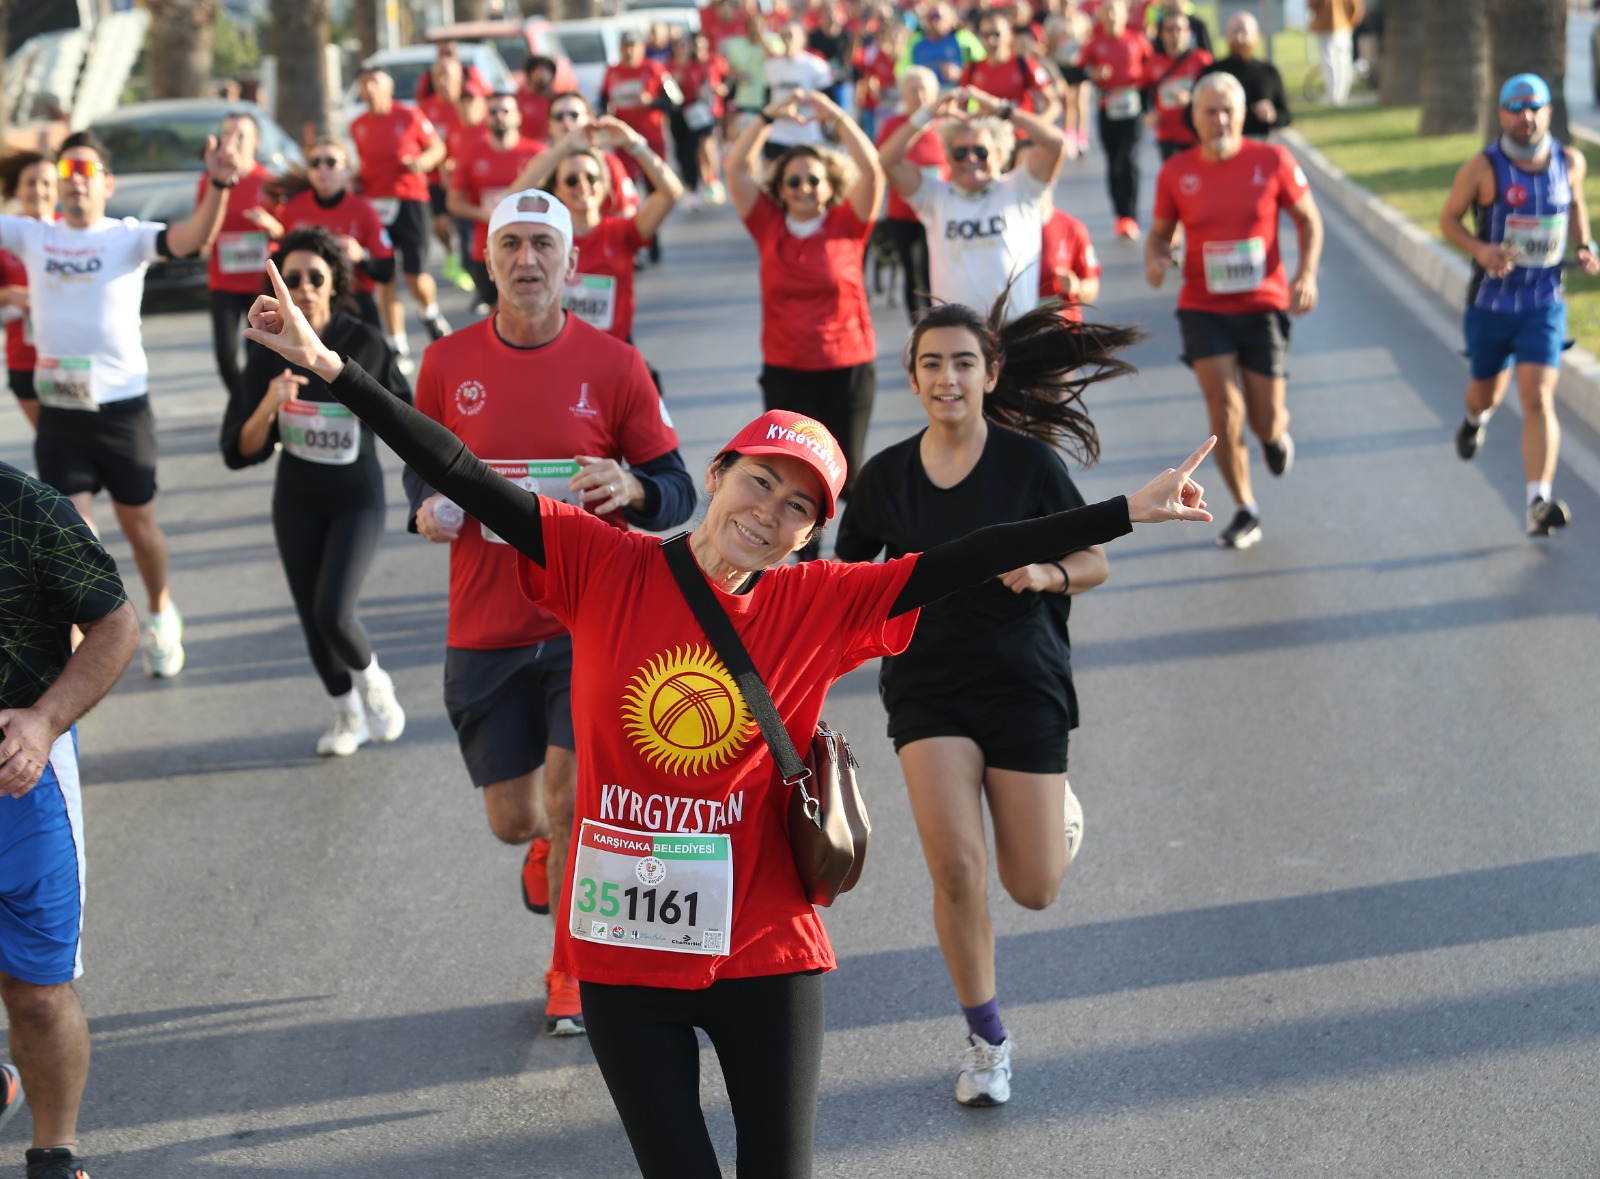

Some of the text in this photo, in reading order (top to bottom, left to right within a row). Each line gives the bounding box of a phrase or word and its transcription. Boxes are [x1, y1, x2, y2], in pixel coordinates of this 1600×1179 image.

[528, 465, 572, 474] BELEDİYESİ
[766, 424, 842, 483] KYRGYZSTAN
[600, 785, 744, 834] KYRGYZSTAN
[593, 832, 715, 854] KARŞIYAKA BELEDİYESİ
[577, 877, 699, 927] 351161
